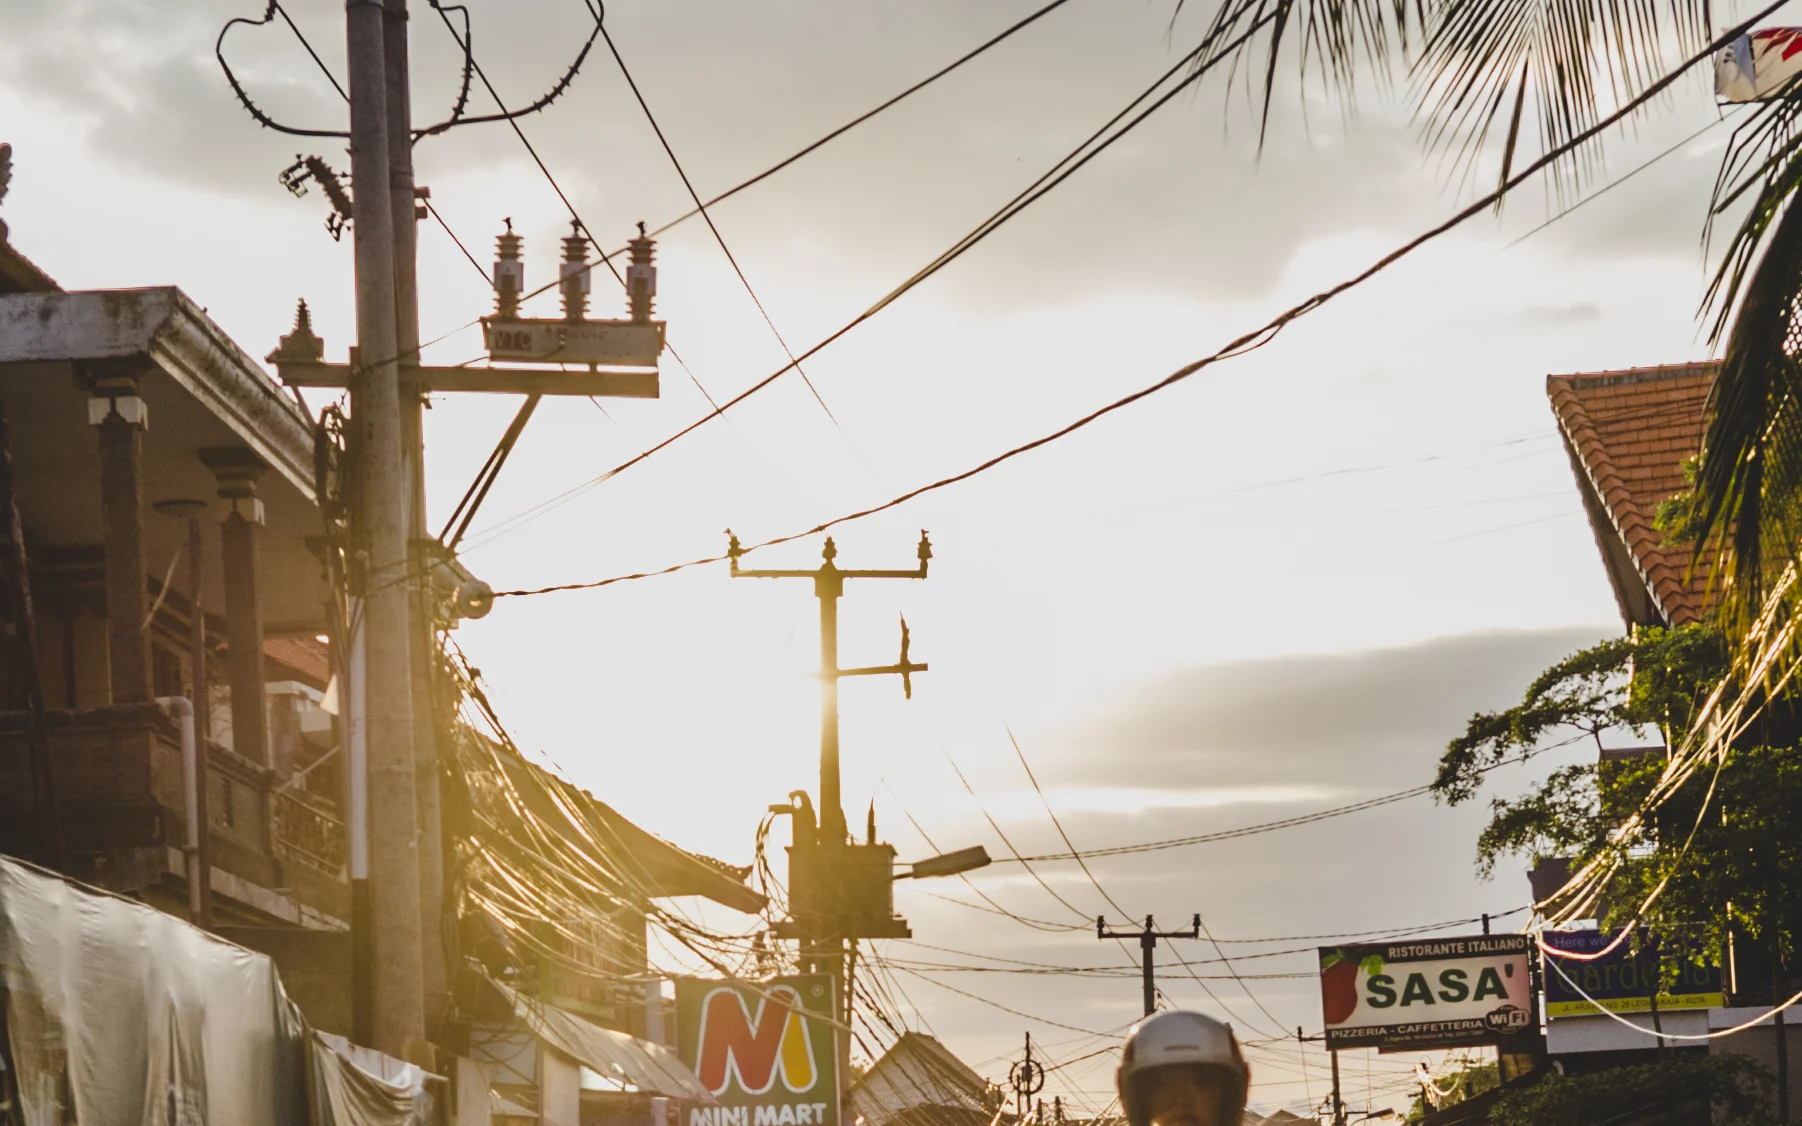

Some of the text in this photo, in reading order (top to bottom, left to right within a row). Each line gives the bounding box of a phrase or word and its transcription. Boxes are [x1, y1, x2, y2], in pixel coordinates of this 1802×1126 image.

[1388, 938, 1525, 958] RISTORANTE ITALIANO
[1554, 936, 1586, 949] Here
[1330, 1026, 1387, 1039] PIZZERIA
[1396, 1019, 1484, 1034] CAFFETTERIA
[754, 1102, 827, 1126] MART
